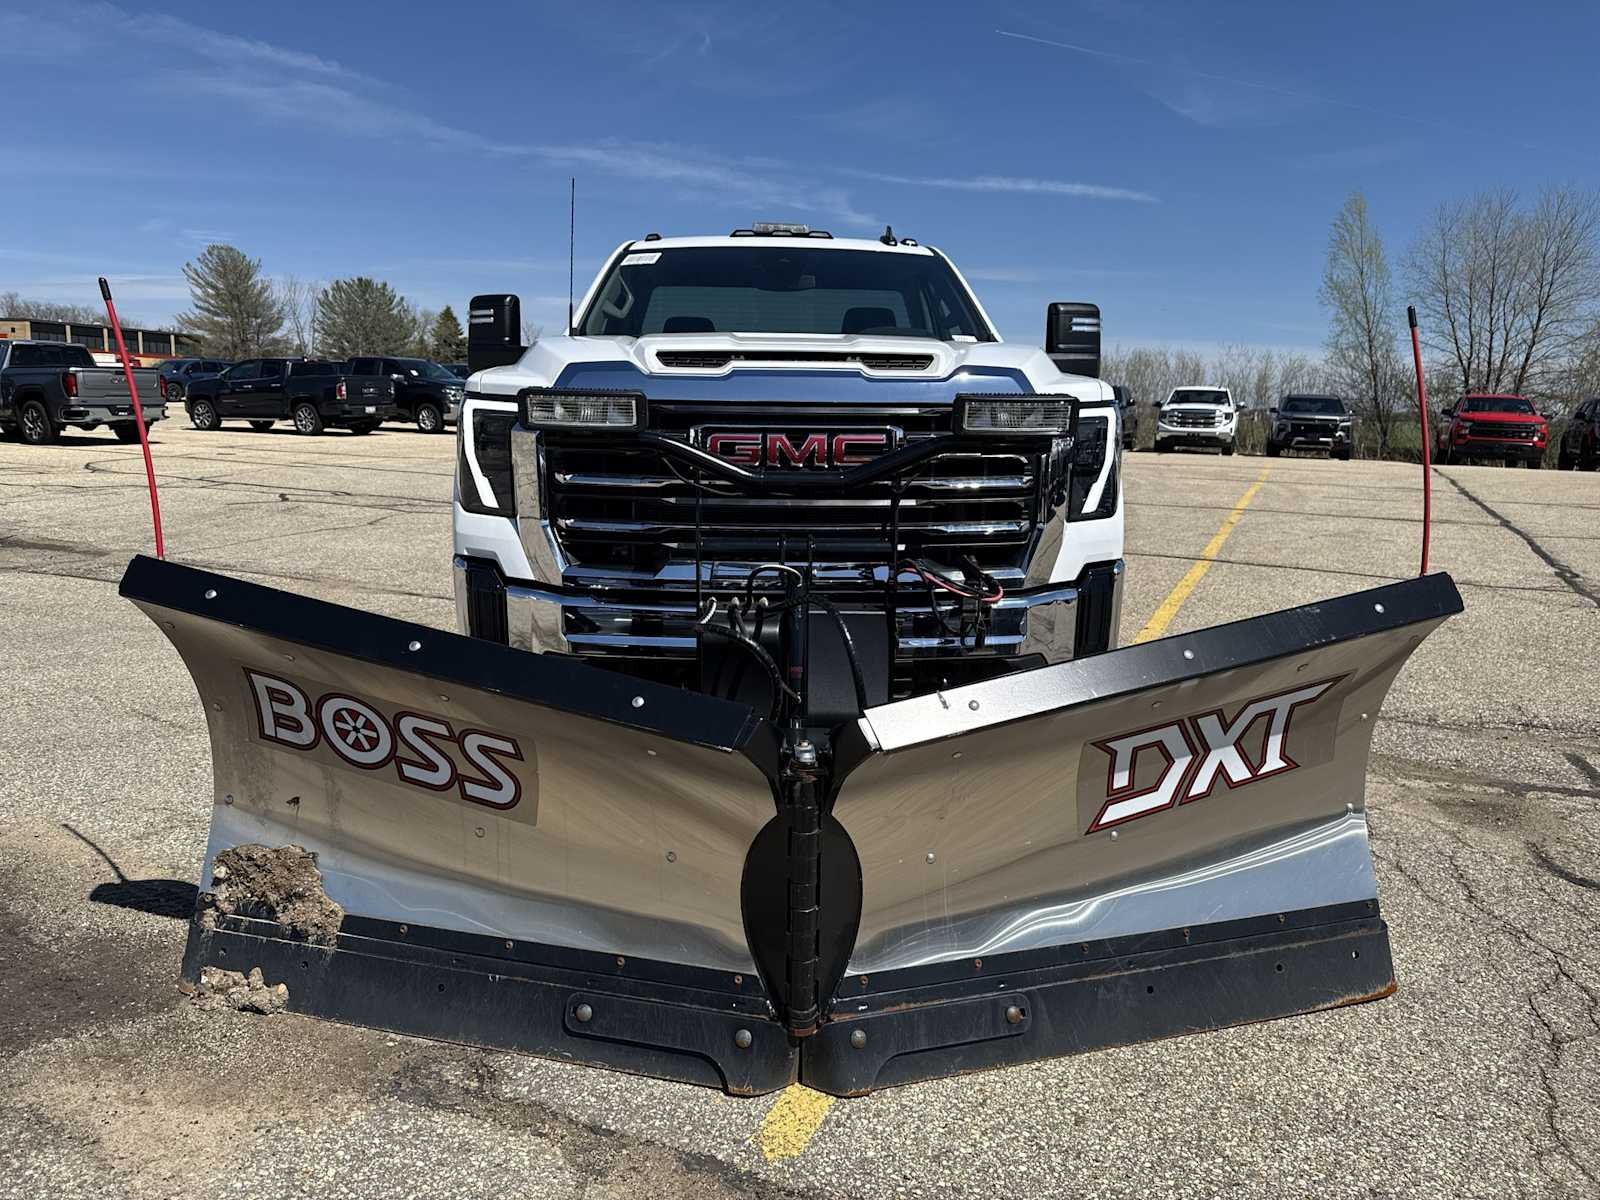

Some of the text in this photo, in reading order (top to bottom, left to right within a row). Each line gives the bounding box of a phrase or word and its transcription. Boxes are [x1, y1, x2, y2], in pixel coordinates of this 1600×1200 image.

[707, 433, 887, 467] GMC
[243, 667, 524, 810] BOSS
[1086, 673, 1351, 834] DXT
